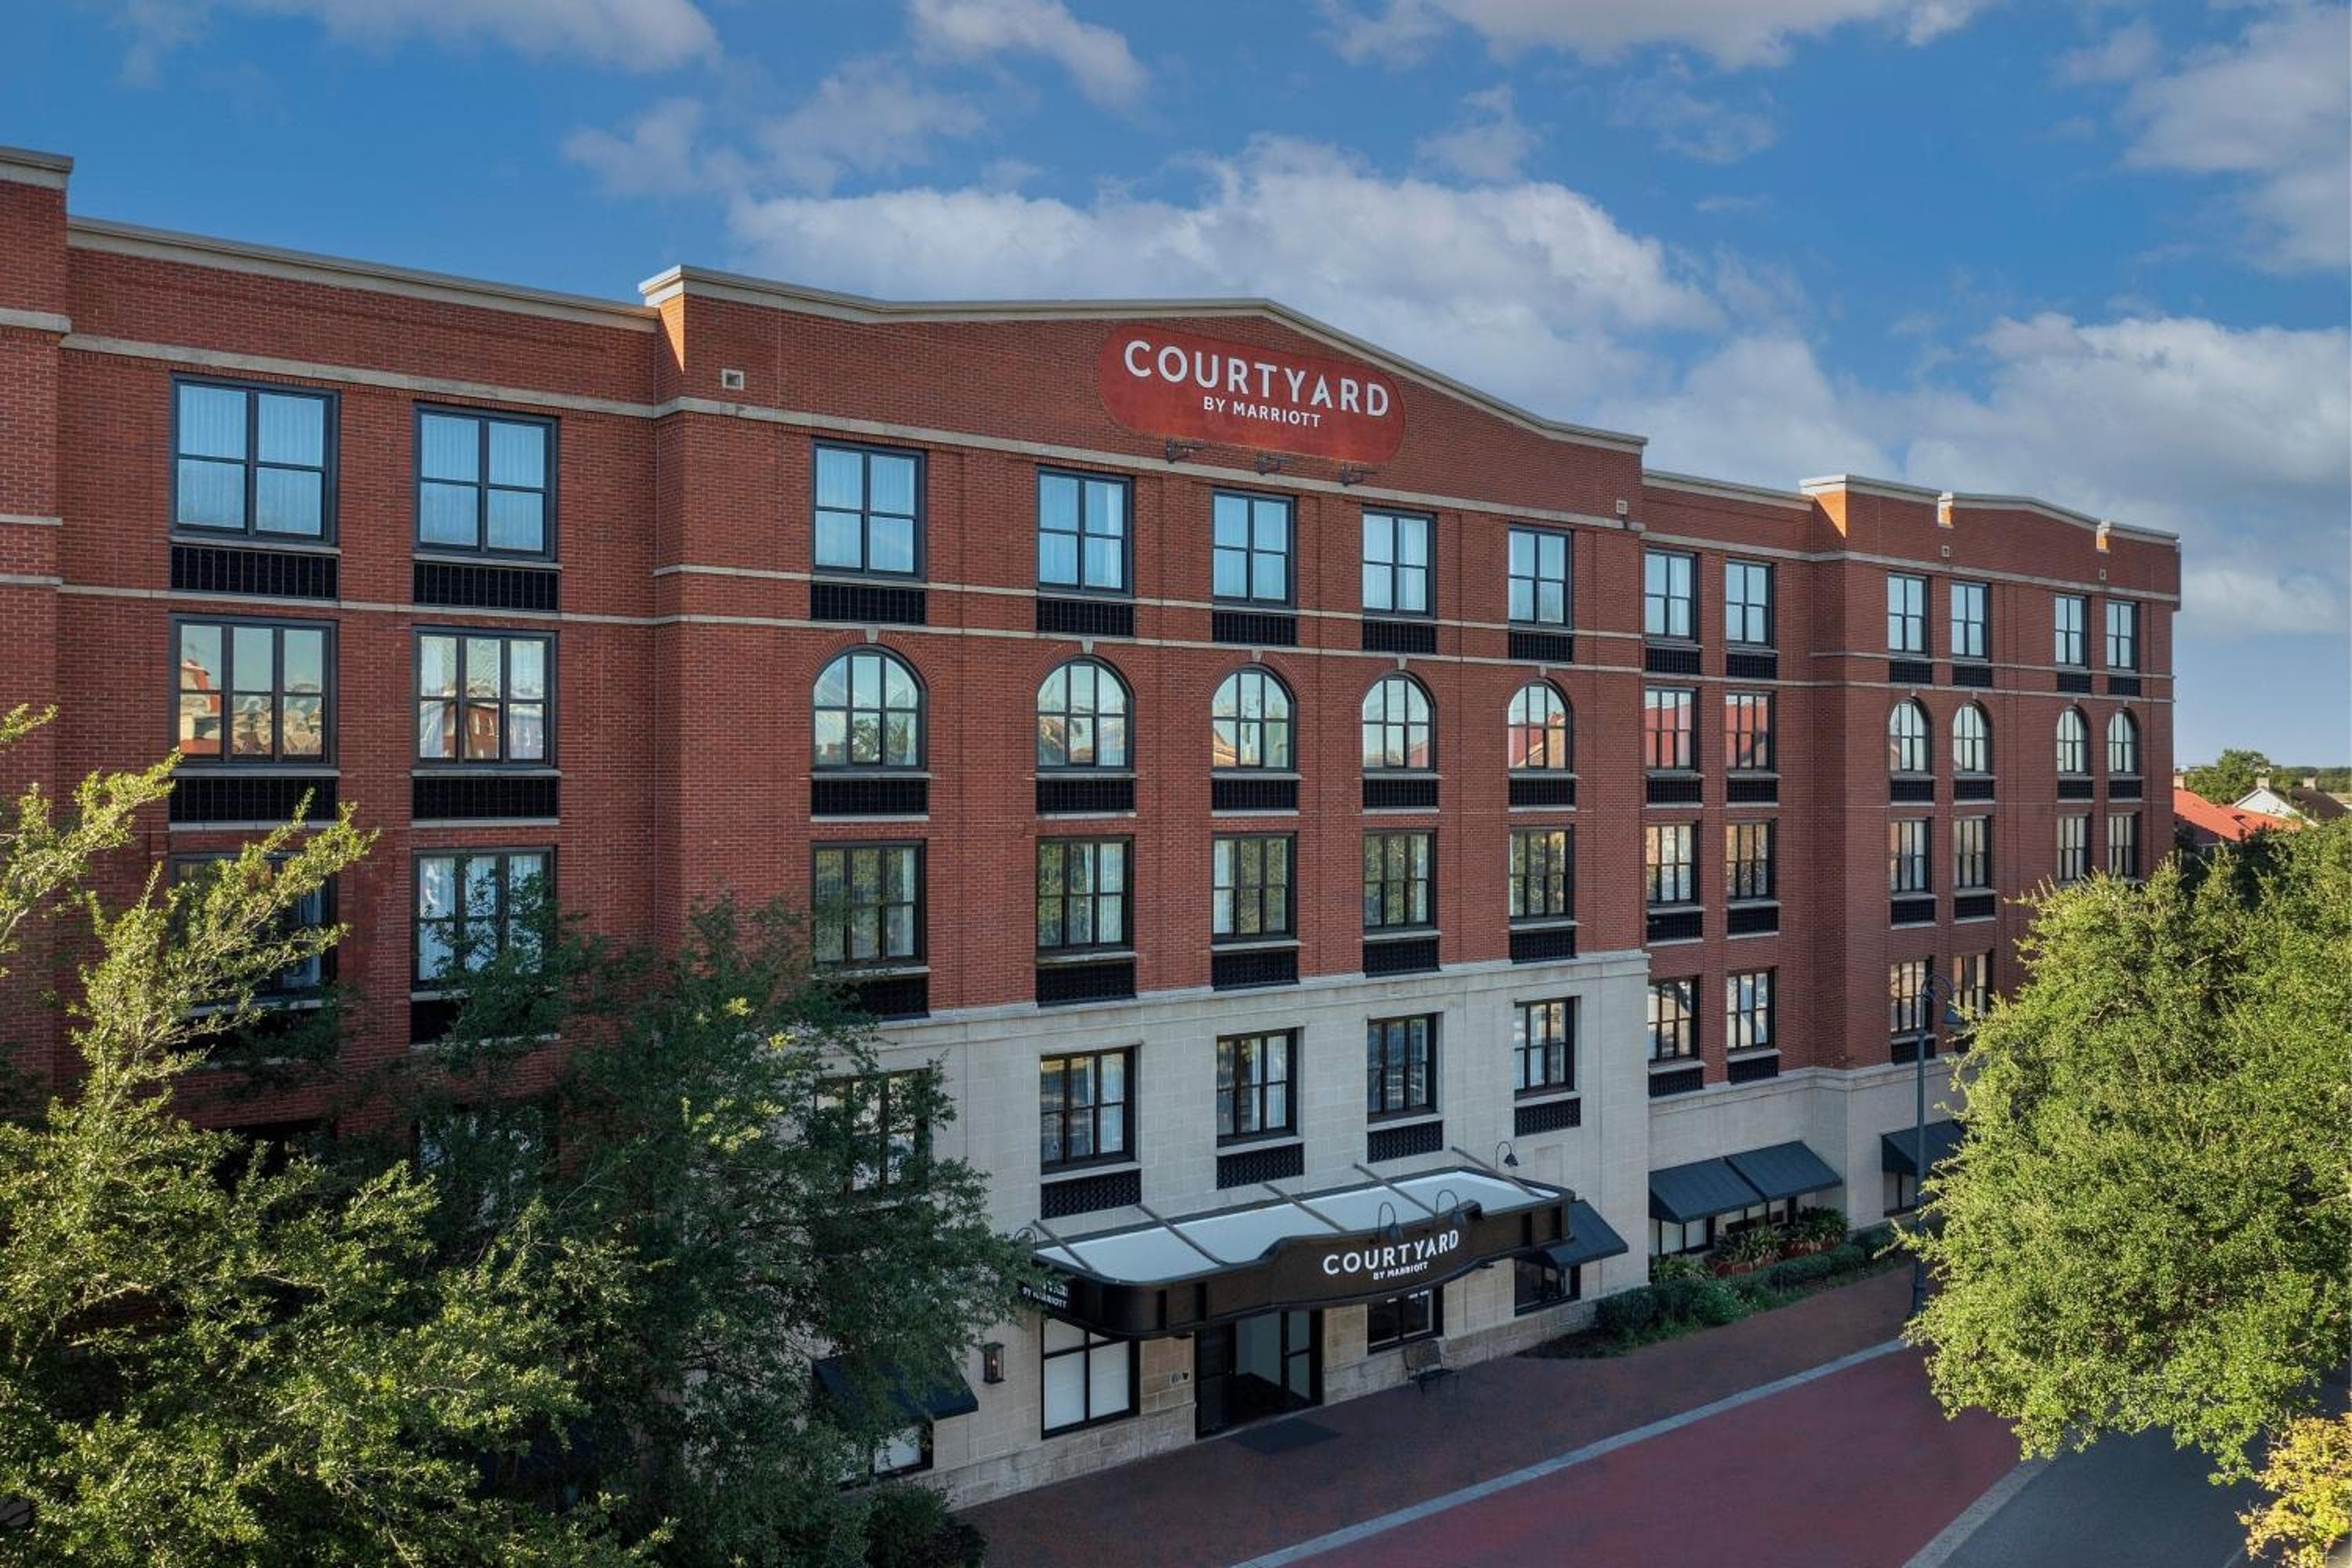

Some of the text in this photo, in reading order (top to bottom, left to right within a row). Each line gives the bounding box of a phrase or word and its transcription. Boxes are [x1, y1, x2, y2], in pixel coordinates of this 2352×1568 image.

[1125, 340, 1388, 417] COURTYARD
[1203, 396, 1322, 427] BY MARRIOTT
[1323, 1229, 1460, 1275] COURTYARD
[1373, 1261, 1428, 1280] BY MARRIOTT
